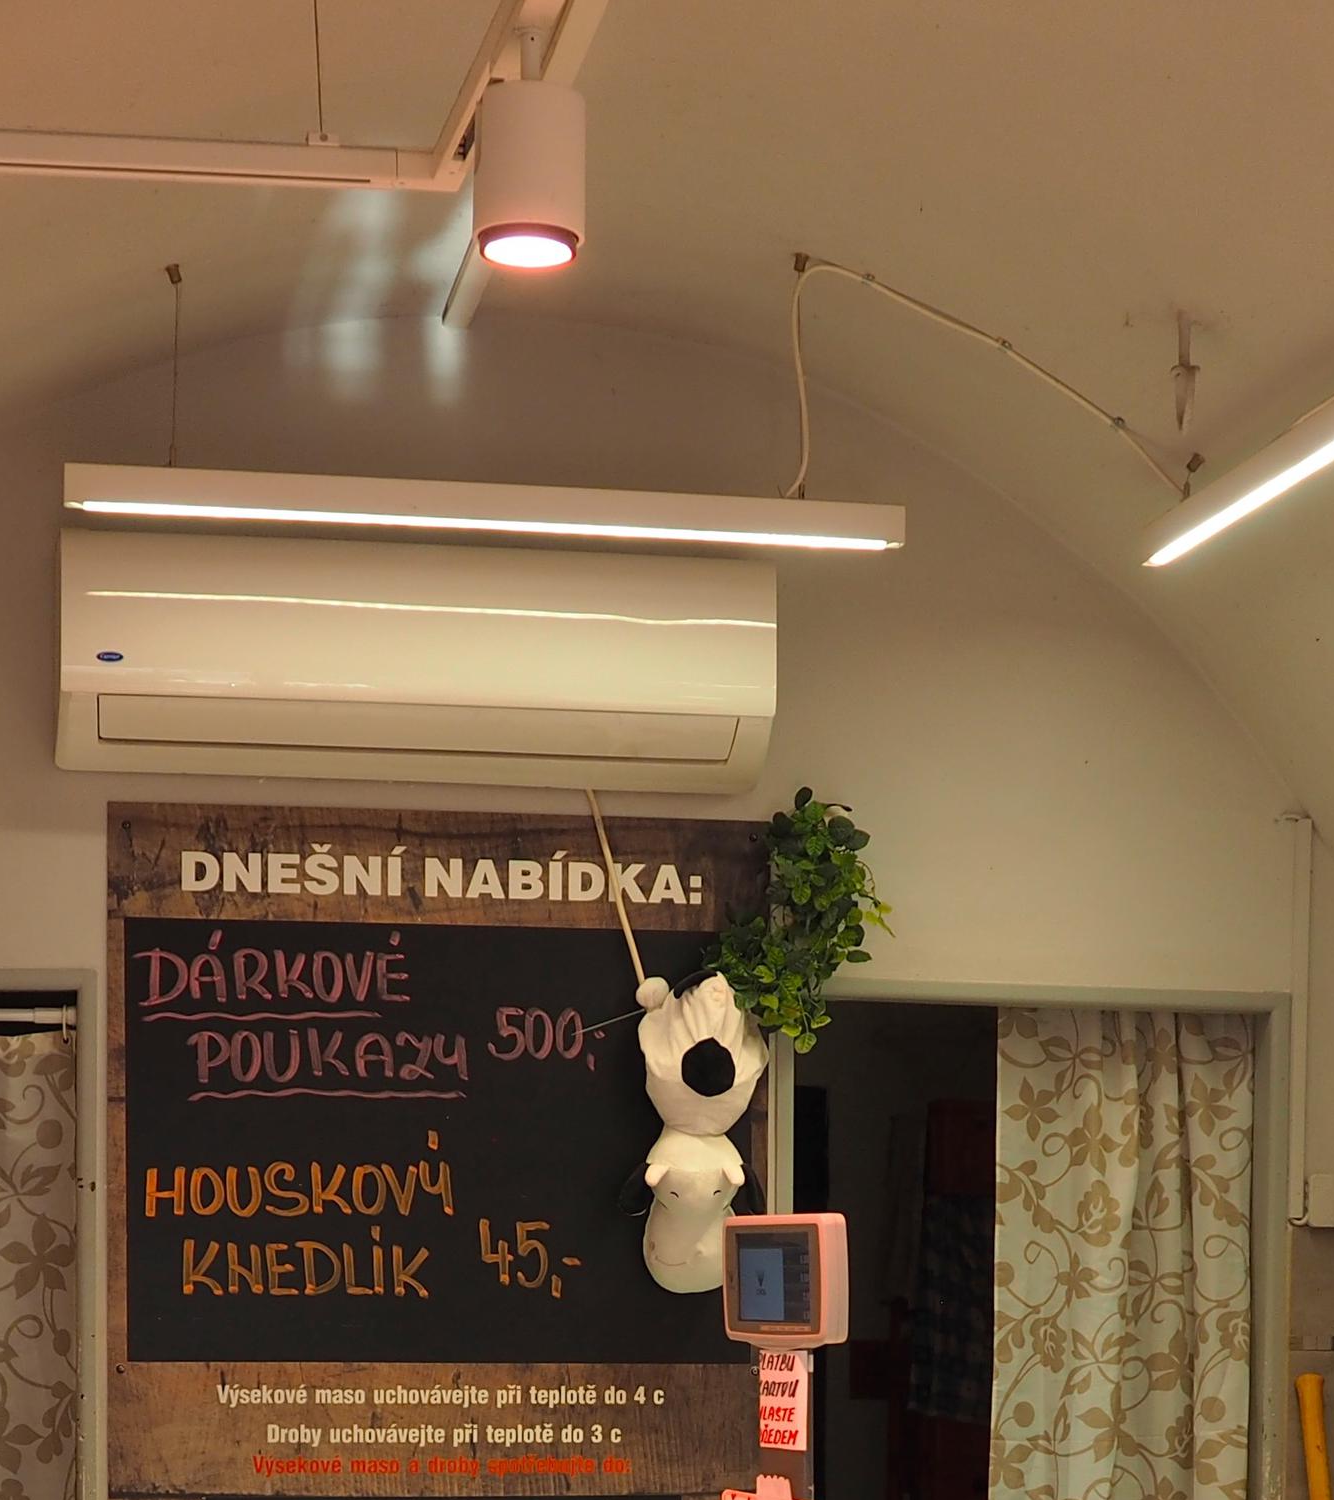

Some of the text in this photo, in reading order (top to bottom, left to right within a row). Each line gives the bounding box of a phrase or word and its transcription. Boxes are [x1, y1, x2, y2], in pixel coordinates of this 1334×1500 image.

[181, 843, 703, 905] DNEŠNÍ NABÍDKA:
[133, 930, 411, 1006] DÁRKOVÉ
[145, 1129, 454, 1218] HOUSKOVÝ
[182, 1225, 430, 1298] KNEDLÍK
[216, 1384, 666, 1409] Výsekové maso uchovávejte při teplotě do 4 c
[252, 1454, 343, 1478] Výsekové
[350, 1458, 401, 1474] maso
[409, 1459, 421, 1474] a
[428, 1455, 480, 1478] droby
[487, 1454, 596, 1479] spotřebujte
[266, 1423, 623, 1448] Droby uchovávejte při teplotě do 3 c
